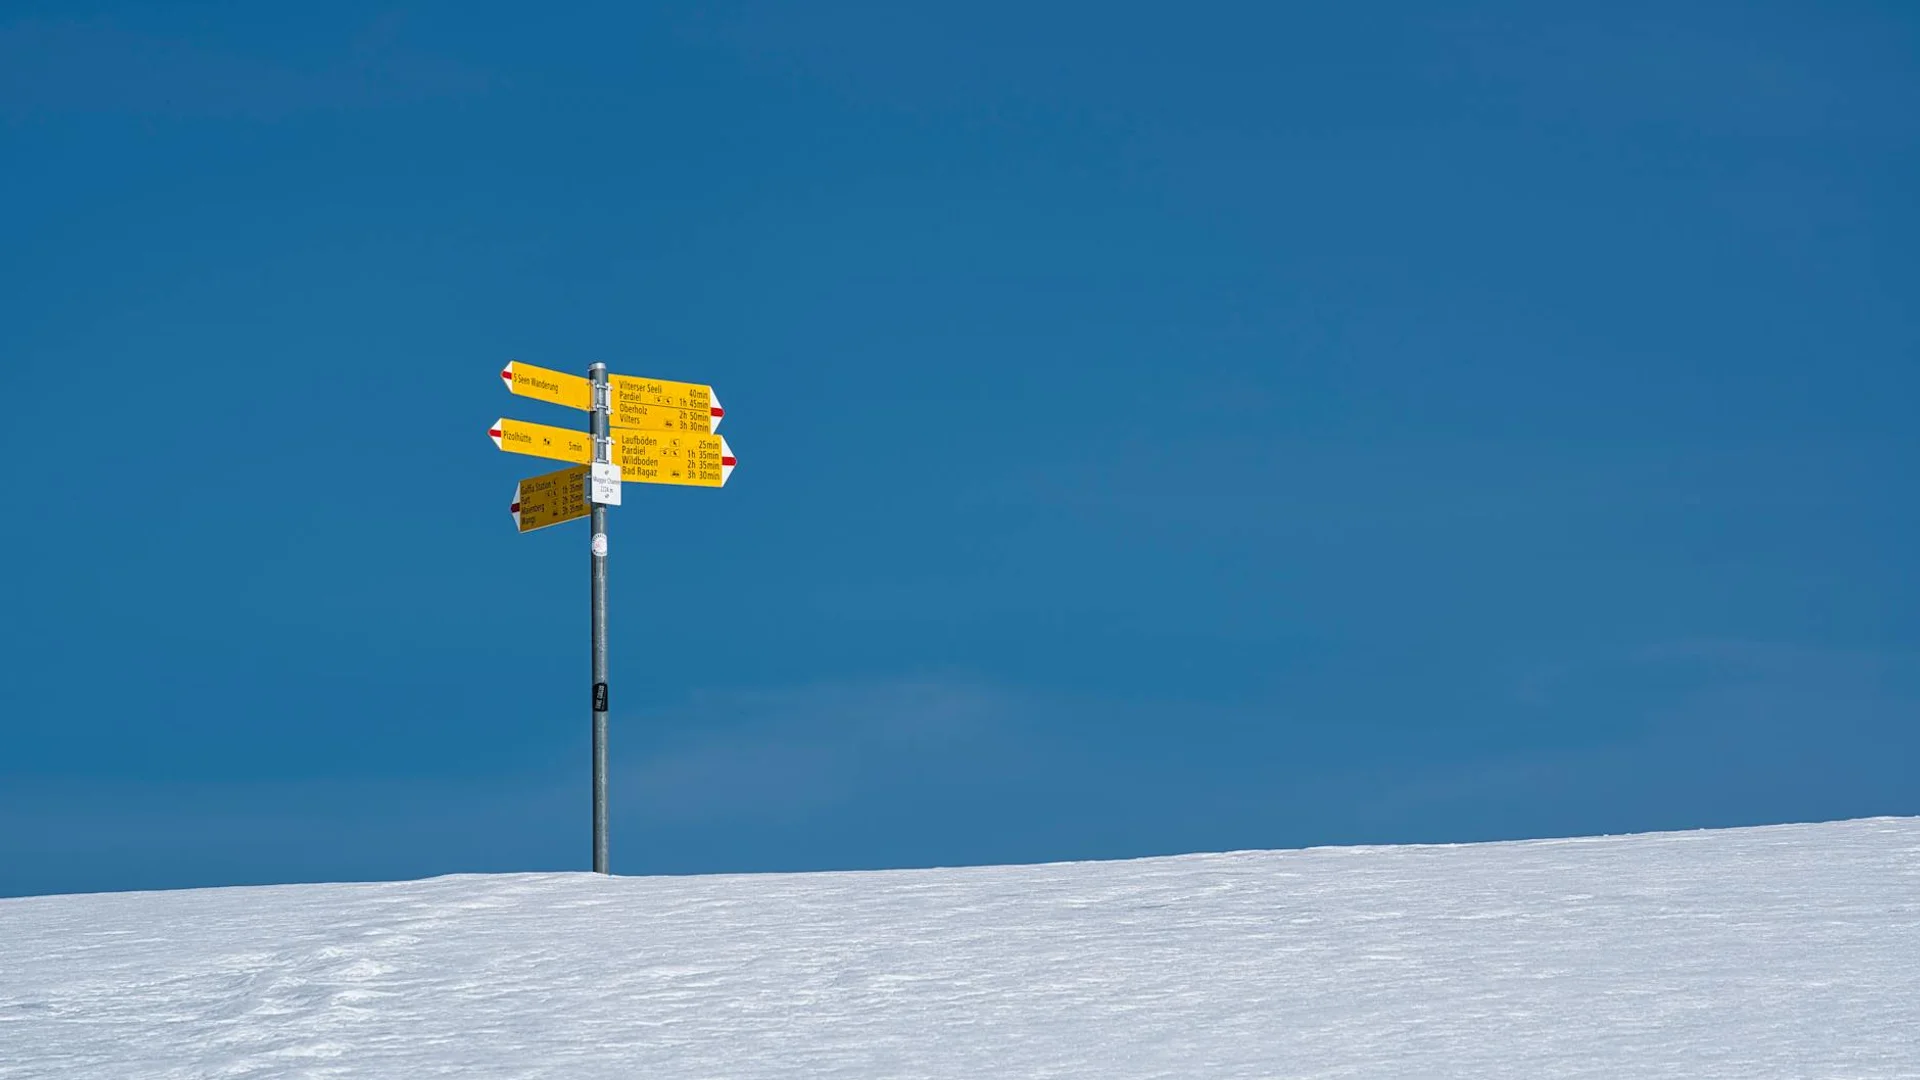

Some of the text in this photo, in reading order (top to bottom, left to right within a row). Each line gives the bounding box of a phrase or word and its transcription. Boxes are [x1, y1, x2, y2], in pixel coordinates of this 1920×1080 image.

[514, 373, 558, 394] 5 Seen Wanderung
[619, 380, 708, 400] Vilterser Seeli 40min
[620, 391, 708, 409] Pardiel 1h 45min
[620, 404, 708, 421] Oberholz 2h 50min
[620, 414, 708, 432] Vilters 3h 30min
[503, 430, 582, 452] Pizolhütte 5min
[622, 435, 719, 449] Laufböden 25min
[622, 446, 719, 460] Pardiel 1h 35min
[622, 456, 720, 470] Wildboden 2h 35min
[622, 466, 720, 480] Bad Ragaz 3h 30min
